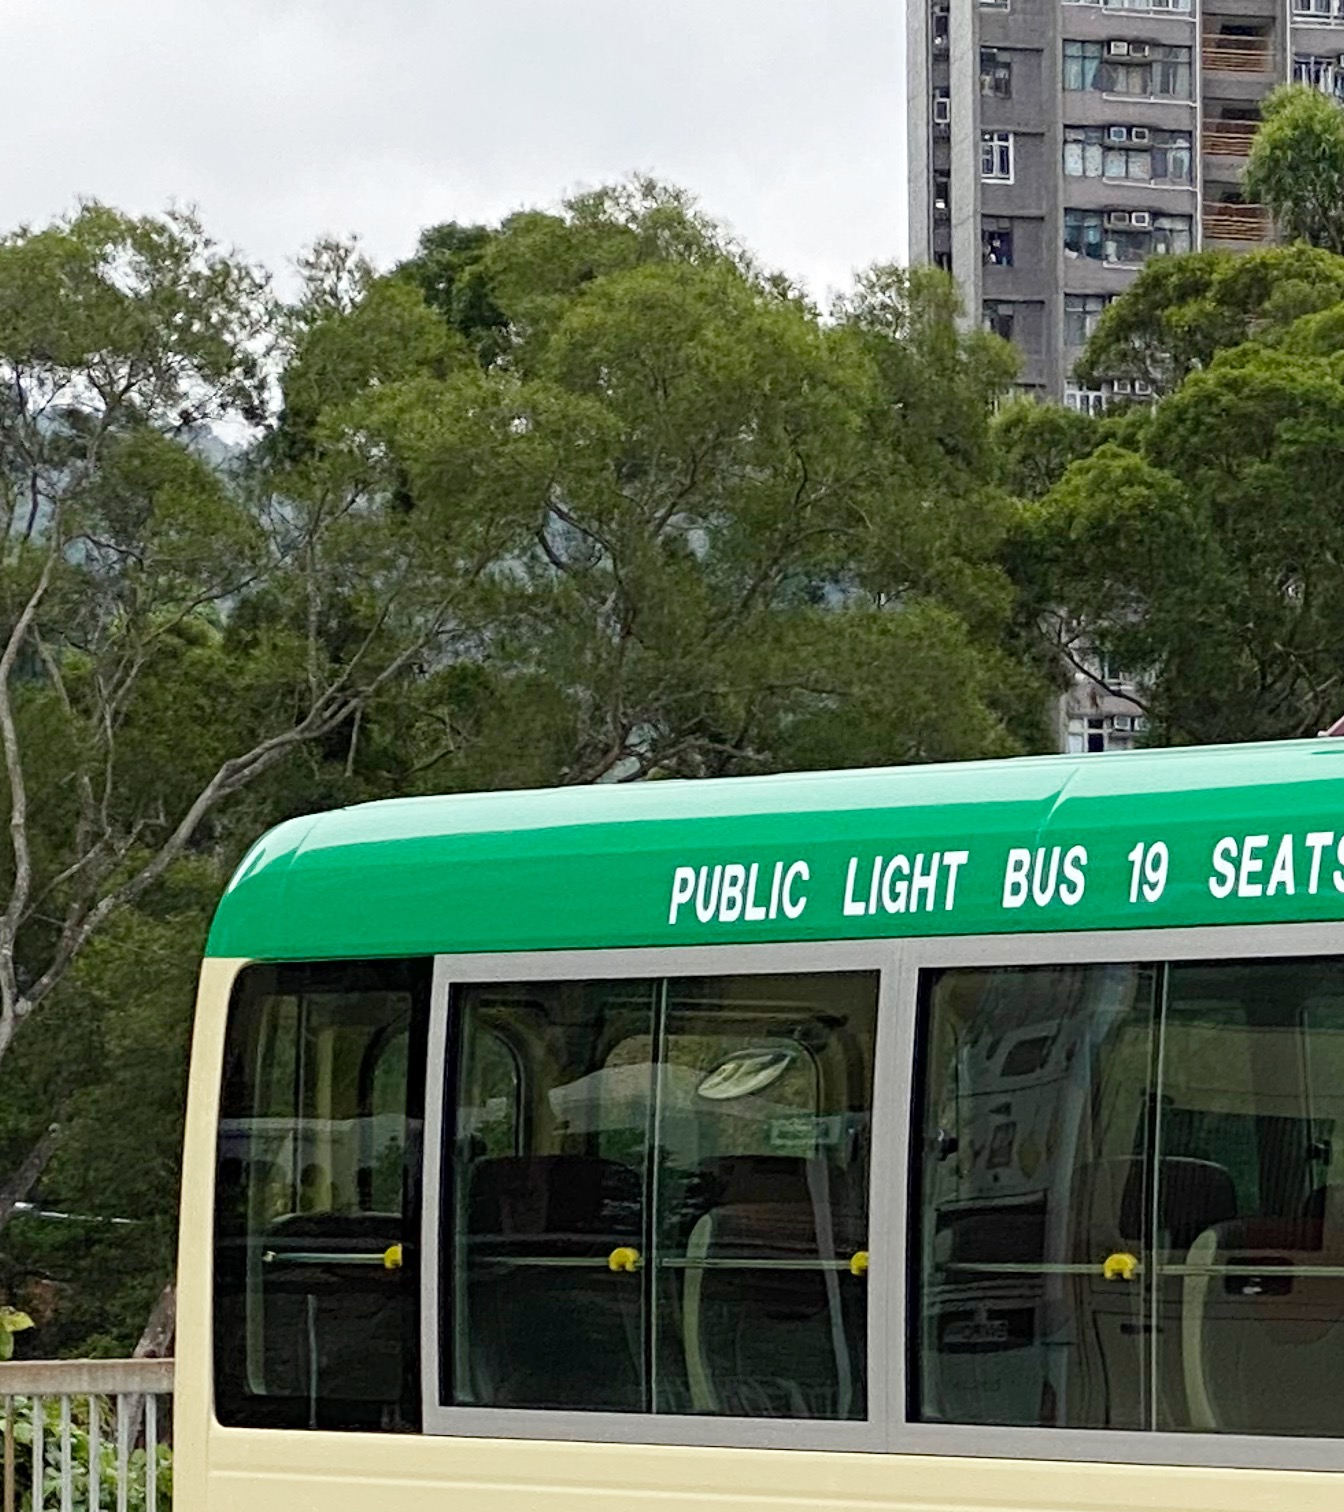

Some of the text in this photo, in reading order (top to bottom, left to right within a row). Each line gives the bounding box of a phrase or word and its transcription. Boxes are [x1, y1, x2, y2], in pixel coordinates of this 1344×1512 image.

[669, 860, 811, 925] PUBLIC
[842, 850, 969, 918] LIGHT
[1002, 845, 1088, 910] BUS
[1127, 841, 1170, 904] 19
